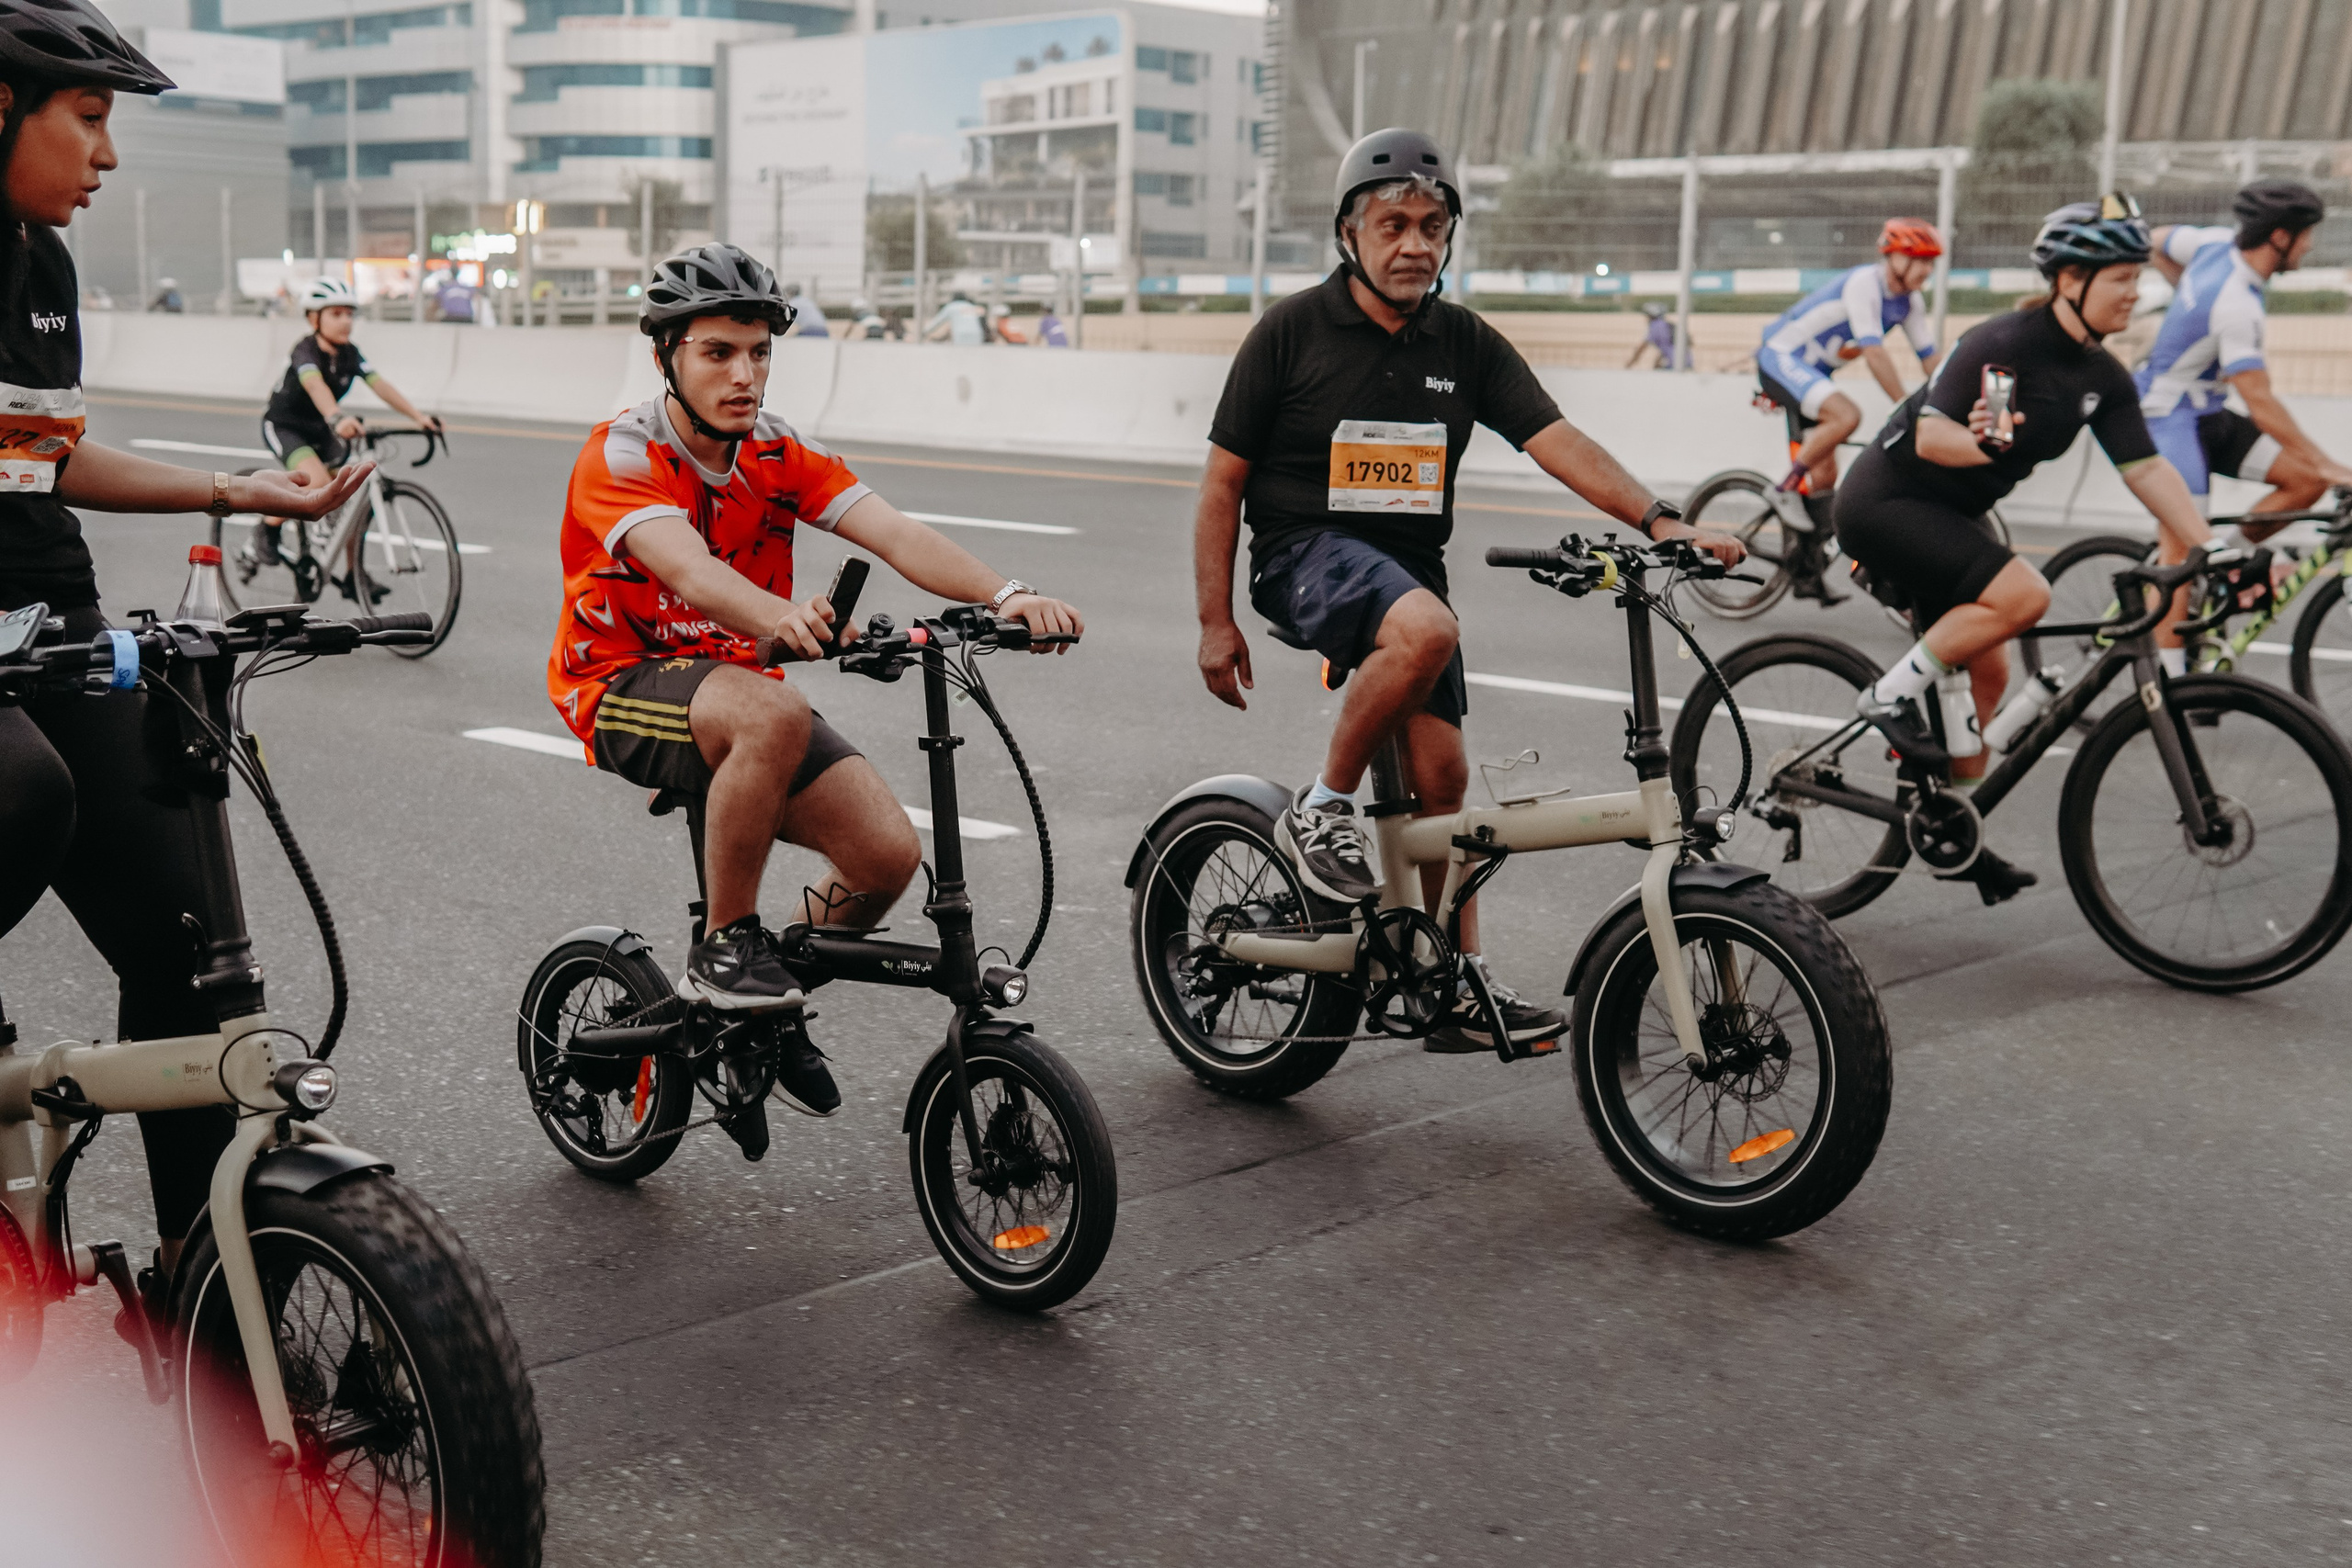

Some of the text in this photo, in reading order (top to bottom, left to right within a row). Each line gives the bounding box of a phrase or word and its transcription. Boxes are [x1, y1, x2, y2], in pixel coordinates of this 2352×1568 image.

[30, 312, 67, 333] Biyiy
[1426, 376, 1456, 393] Biyiy
[0, 427, 40, 450] 27
[1415, 449, 1439, 457] 12KM
[1346, 461, 1413, 483] 17902
[903, 960, 921, 972] Biyiy
